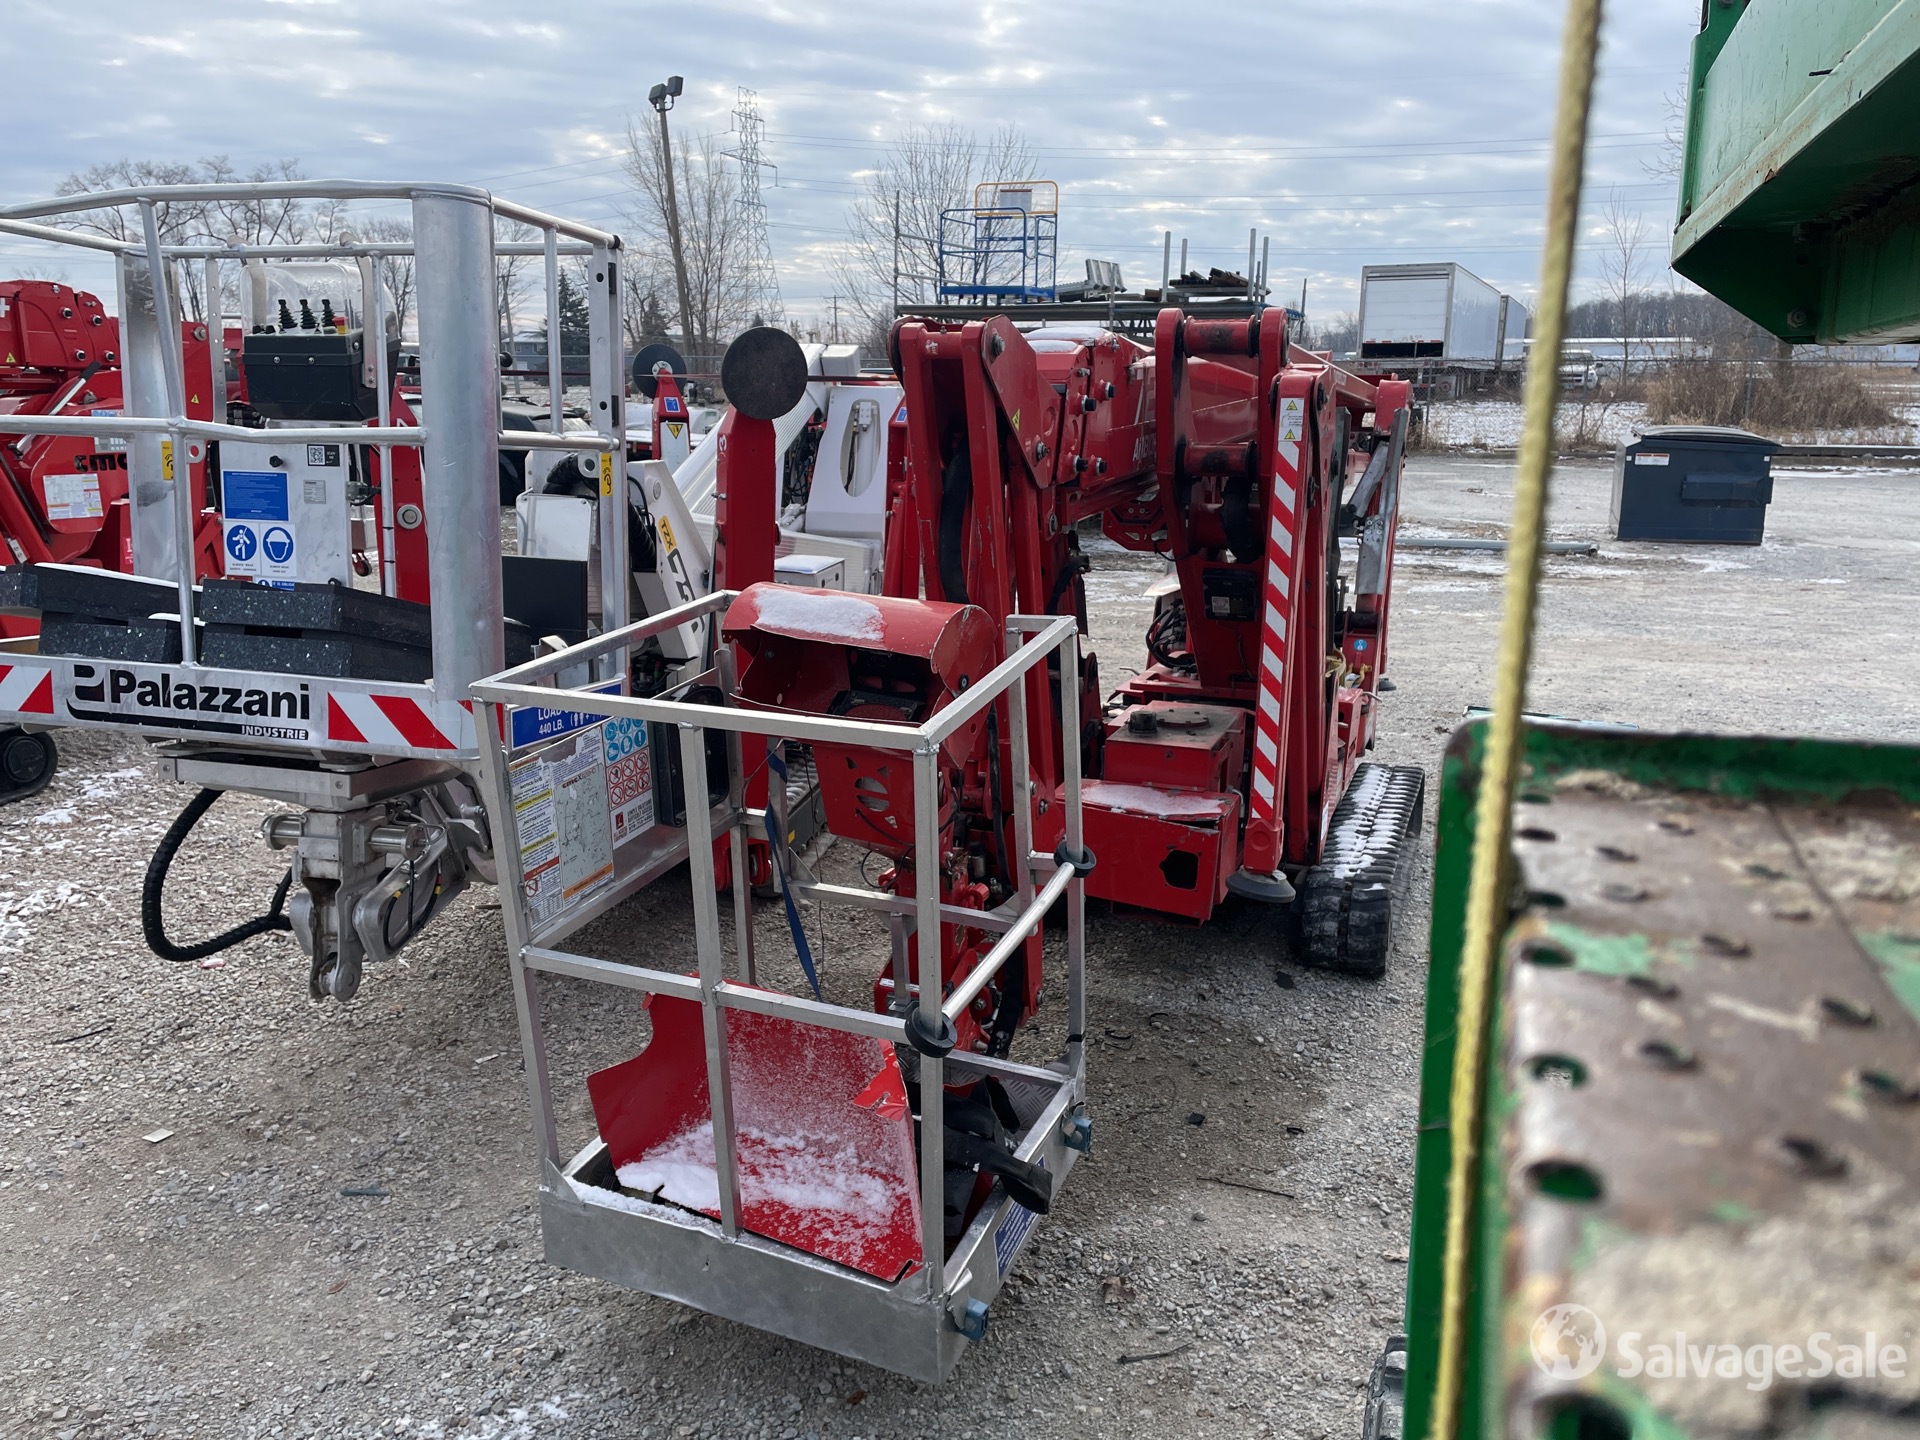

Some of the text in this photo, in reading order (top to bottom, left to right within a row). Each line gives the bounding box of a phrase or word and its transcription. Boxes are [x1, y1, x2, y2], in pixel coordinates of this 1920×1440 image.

[661, 519, 674, 549] TZX
[110, 669, 311, 720] Palazzani
[241, 724, 307, 741] INDUSTRIE
[539, 724, 552, 735] 440
